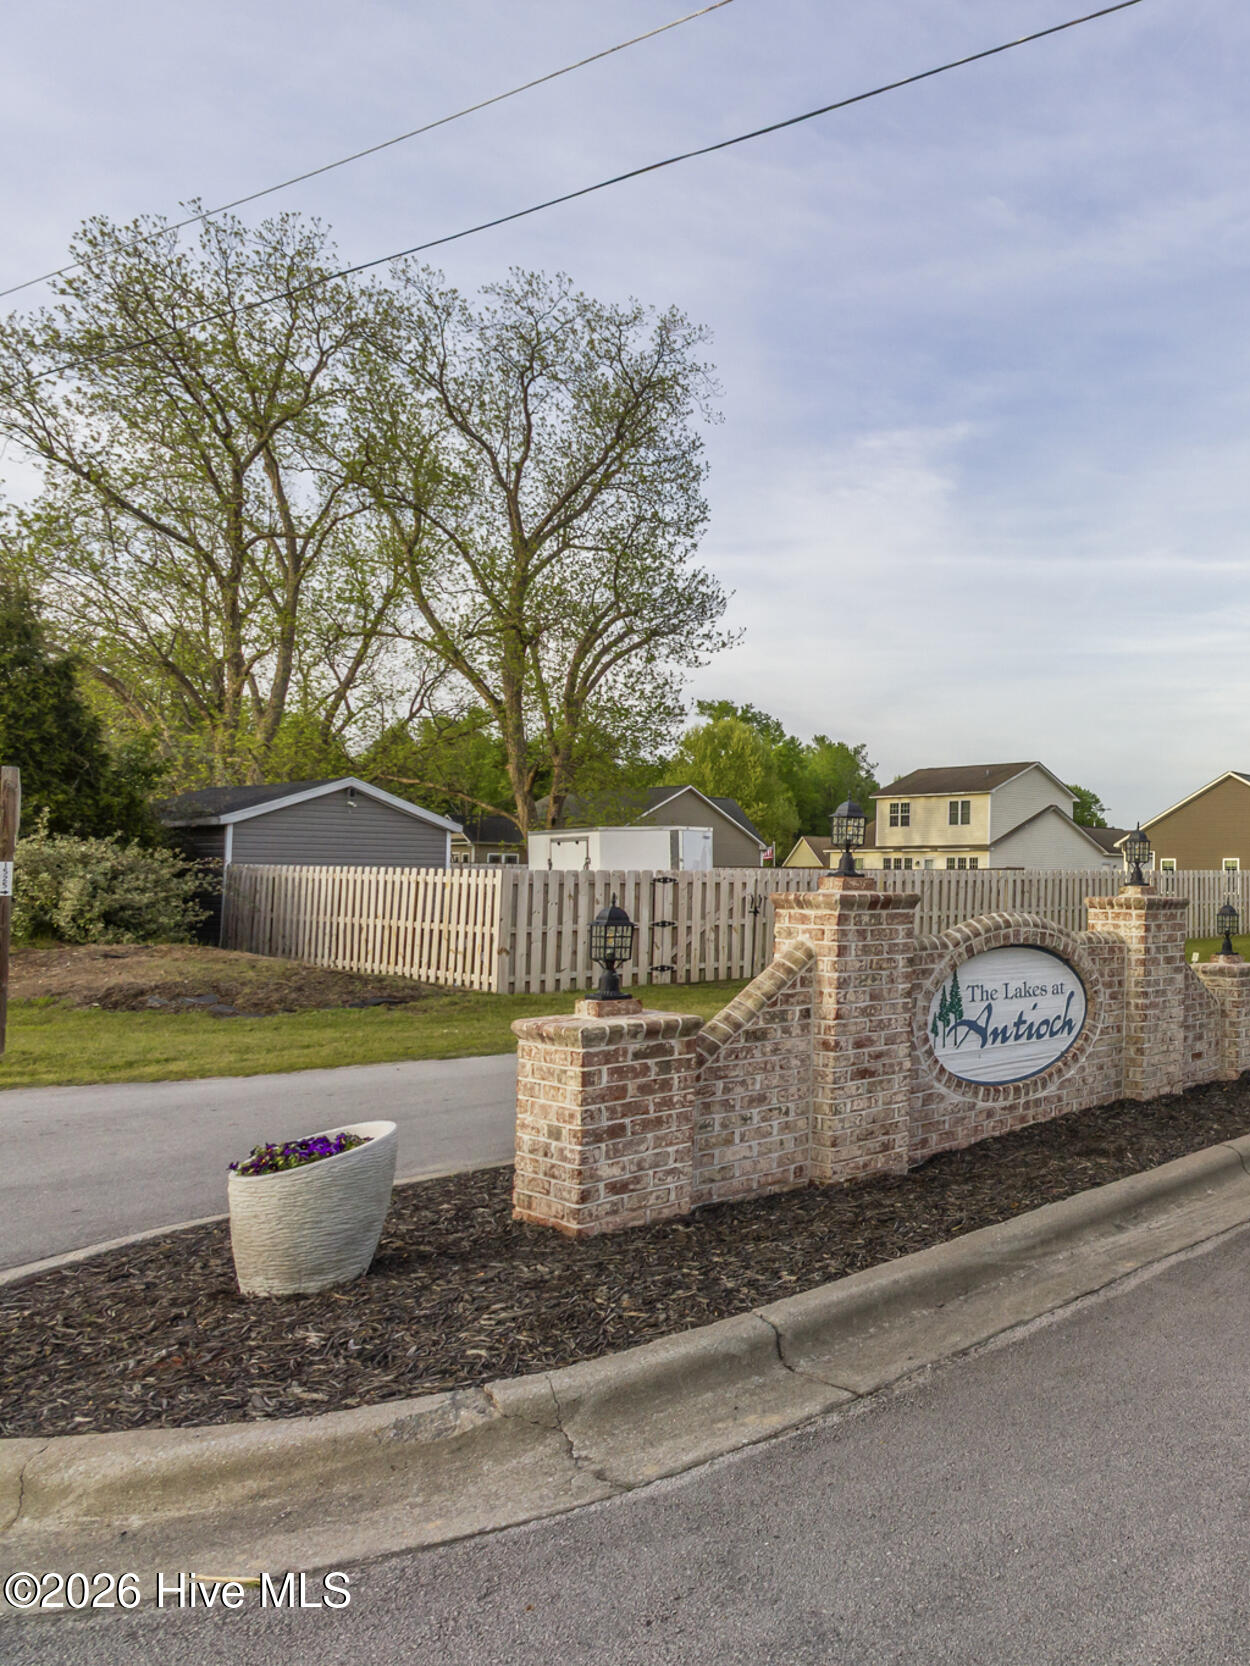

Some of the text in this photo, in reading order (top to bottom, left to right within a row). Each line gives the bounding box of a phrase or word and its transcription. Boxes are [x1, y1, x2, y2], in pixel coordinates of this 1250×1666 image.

[967, 981, 1065, 1002] The Lakes at
[946, 990, 1076, 1049] Antioch
